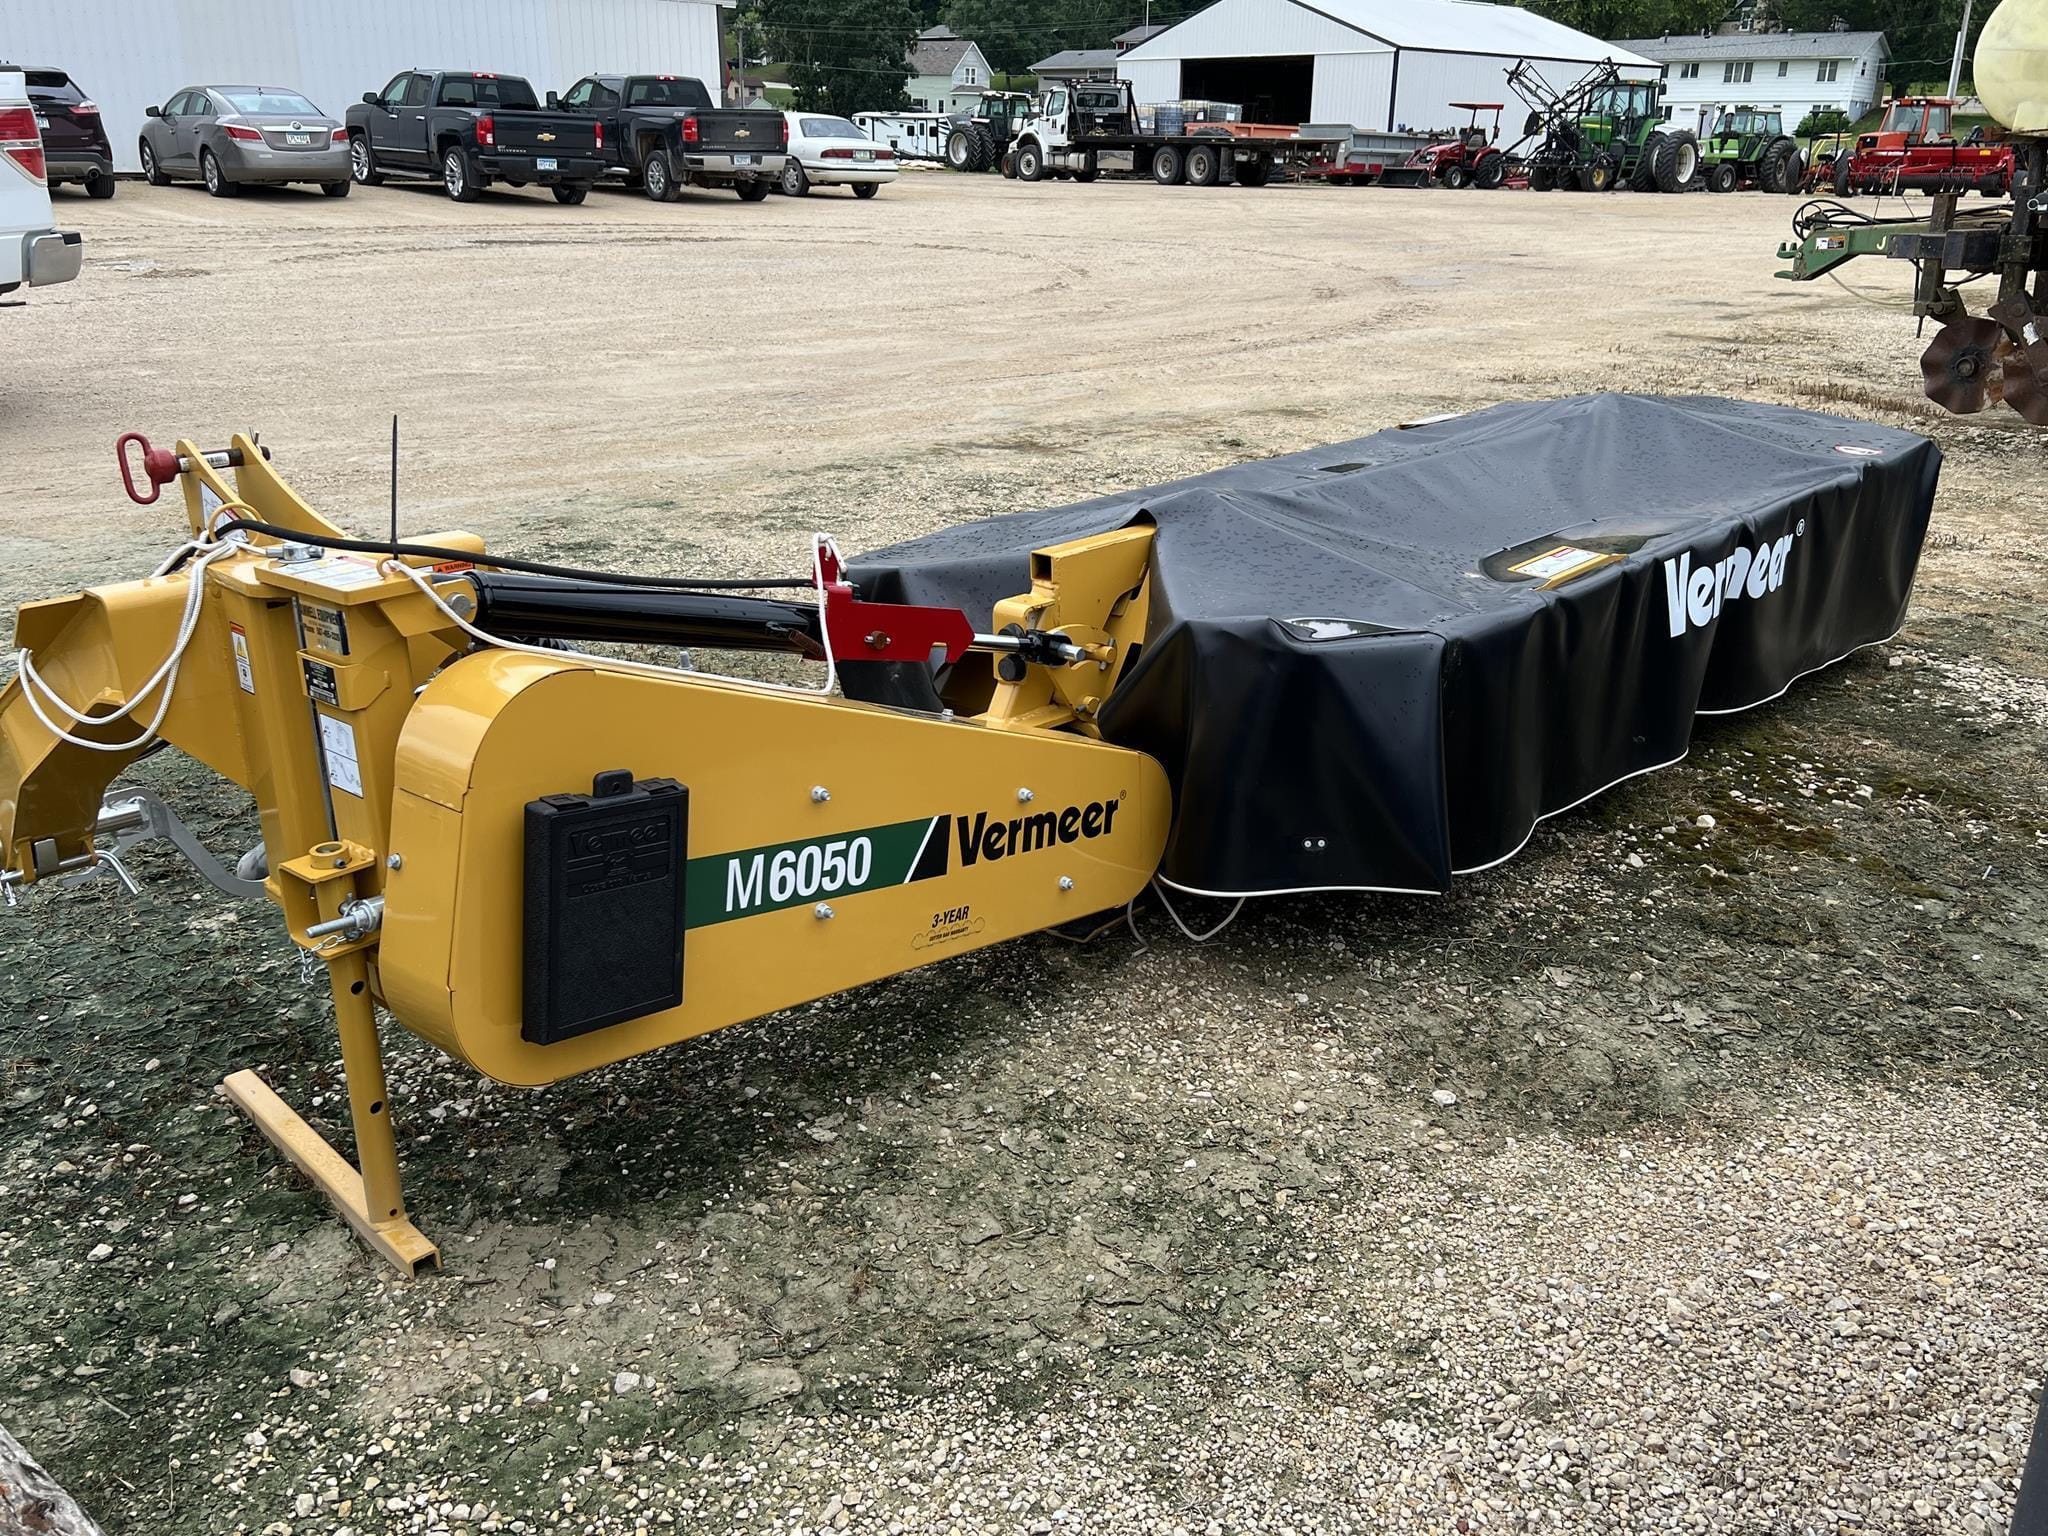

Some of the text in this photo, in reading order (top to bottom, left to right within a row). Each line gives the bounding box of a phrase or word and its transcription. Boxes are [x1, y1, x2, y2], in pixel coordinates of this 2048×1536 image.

[724, 798, 1120, 912] M6050 Vermeer
[932, 905, 970, 928] 3-YEAR
